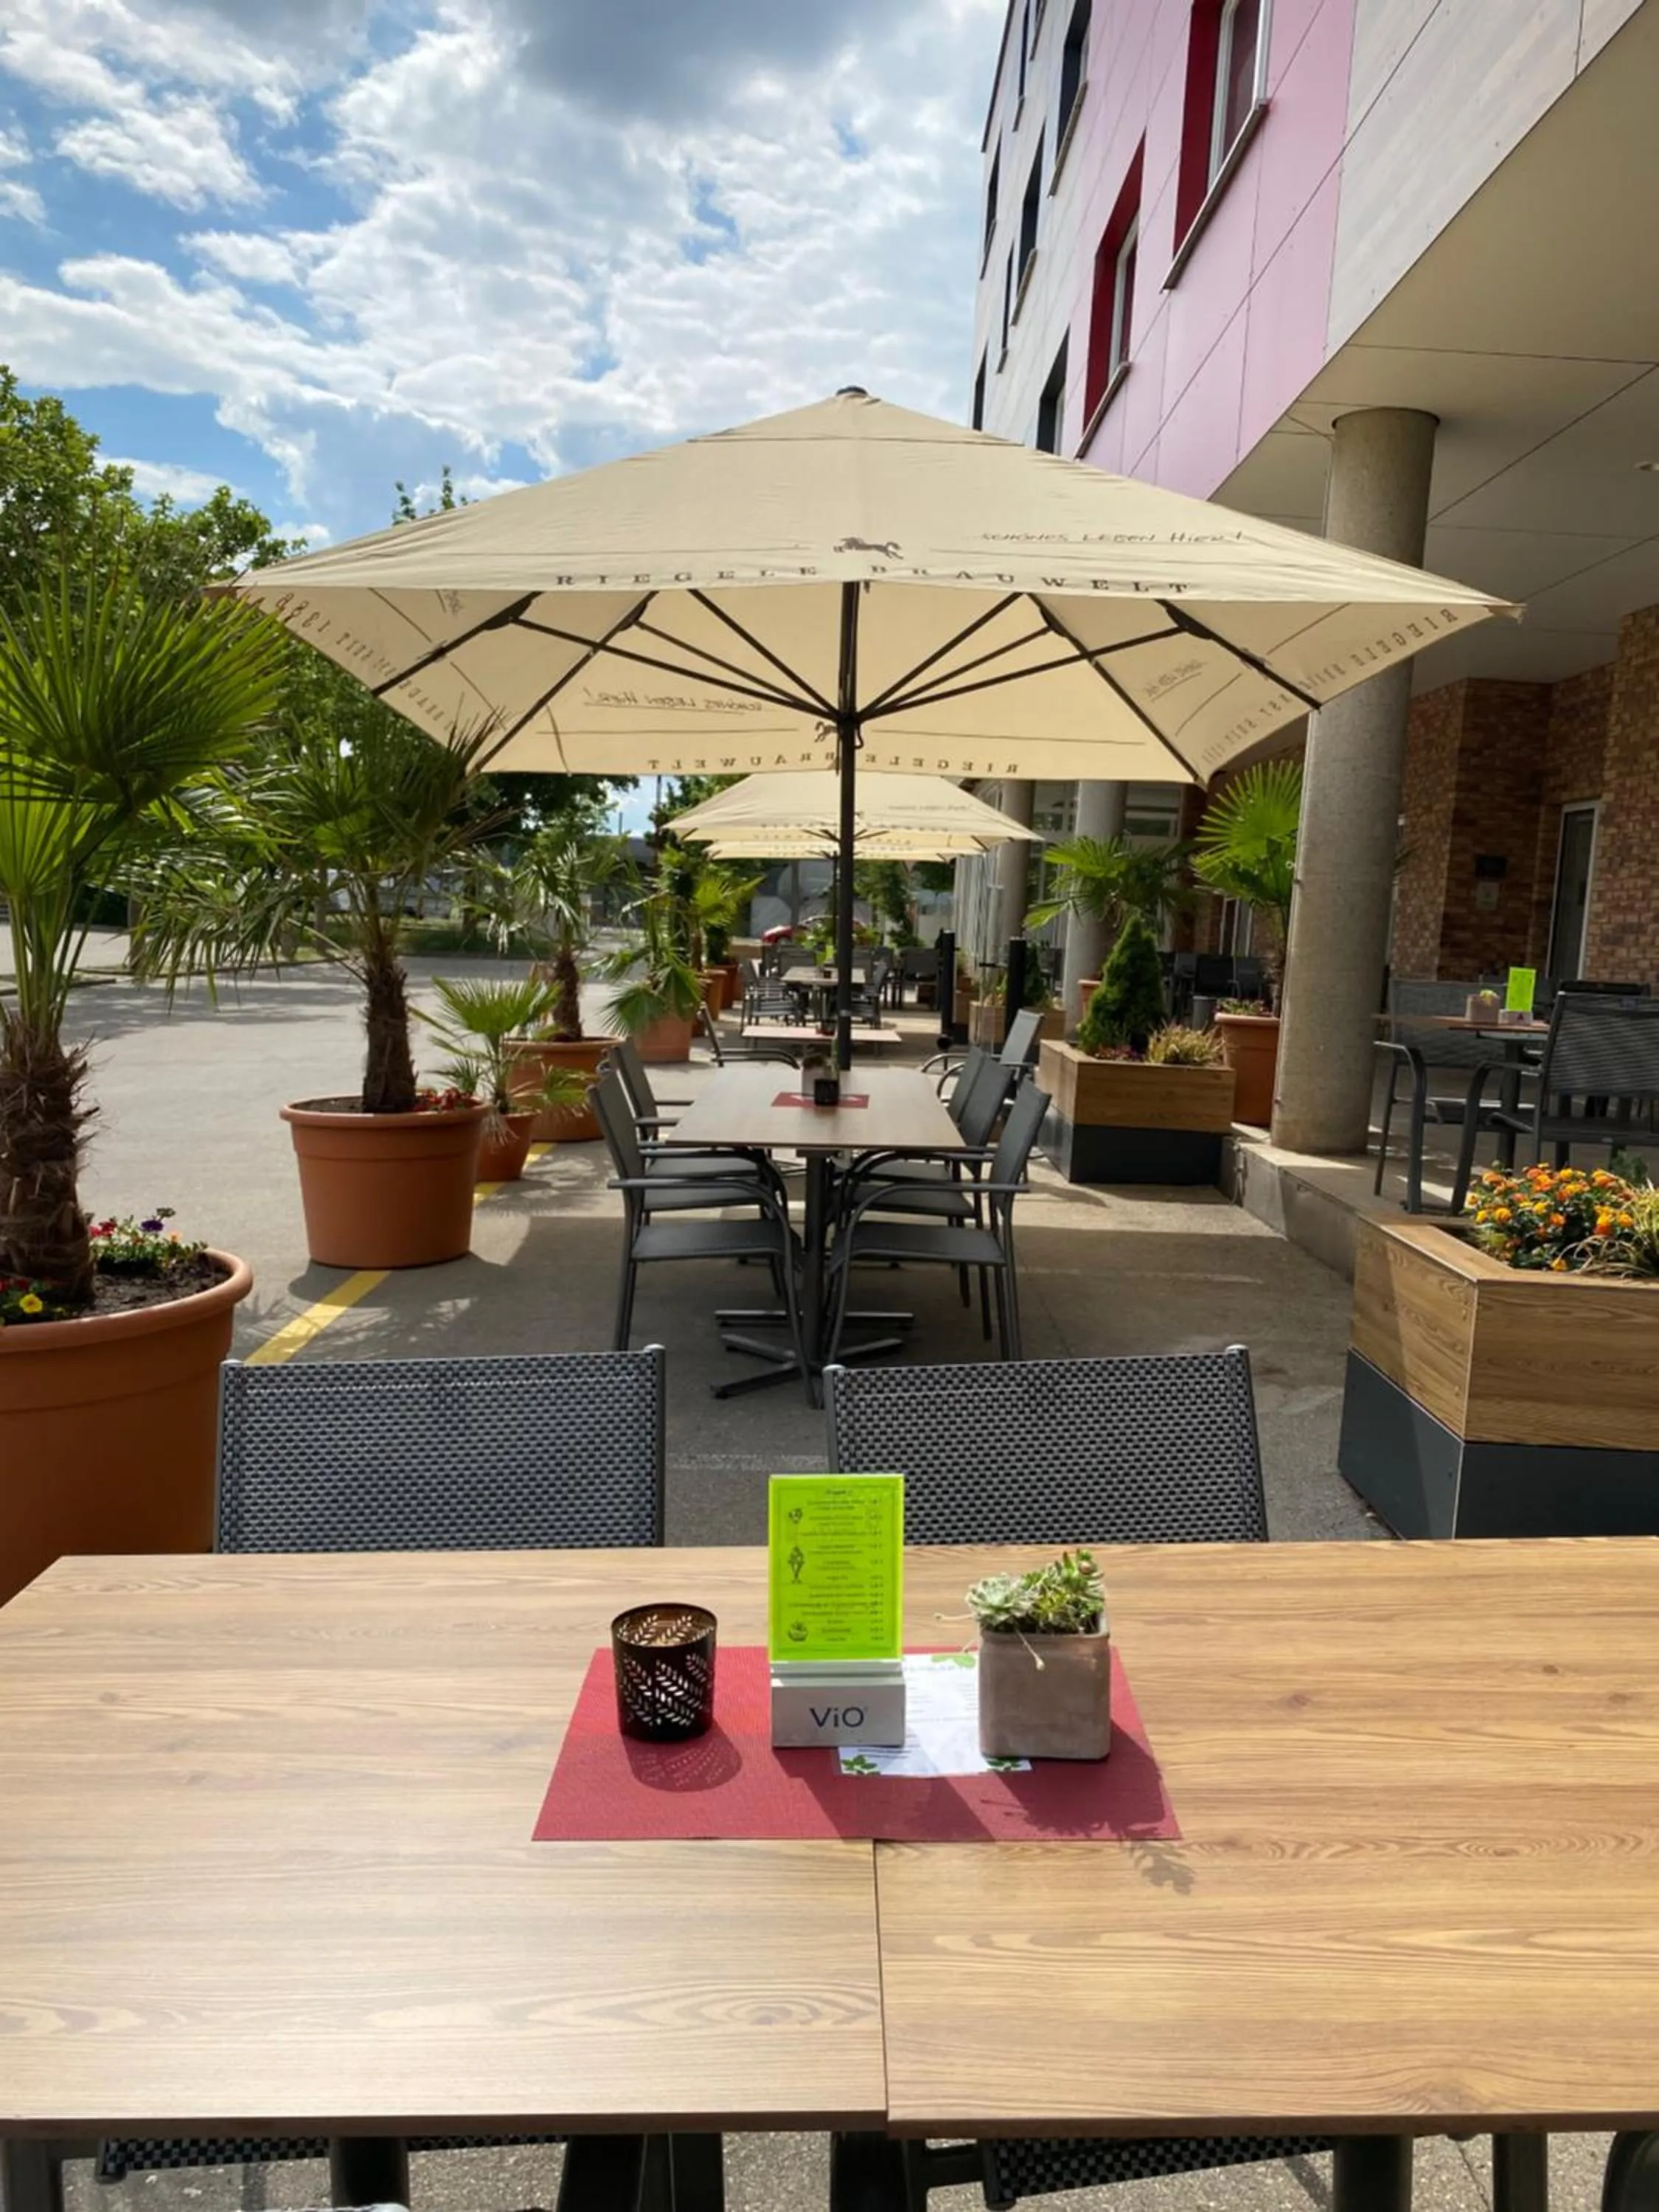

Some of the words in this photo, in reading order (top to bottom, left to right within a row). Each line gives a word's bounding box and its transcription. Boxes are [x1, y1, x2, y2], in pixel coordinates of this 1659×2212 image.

[555, 566, 817, 585] RIEGELE
[870, 565, 1191, 594] BRAUWELT
[810, 1706, 864, 1728] ViO
